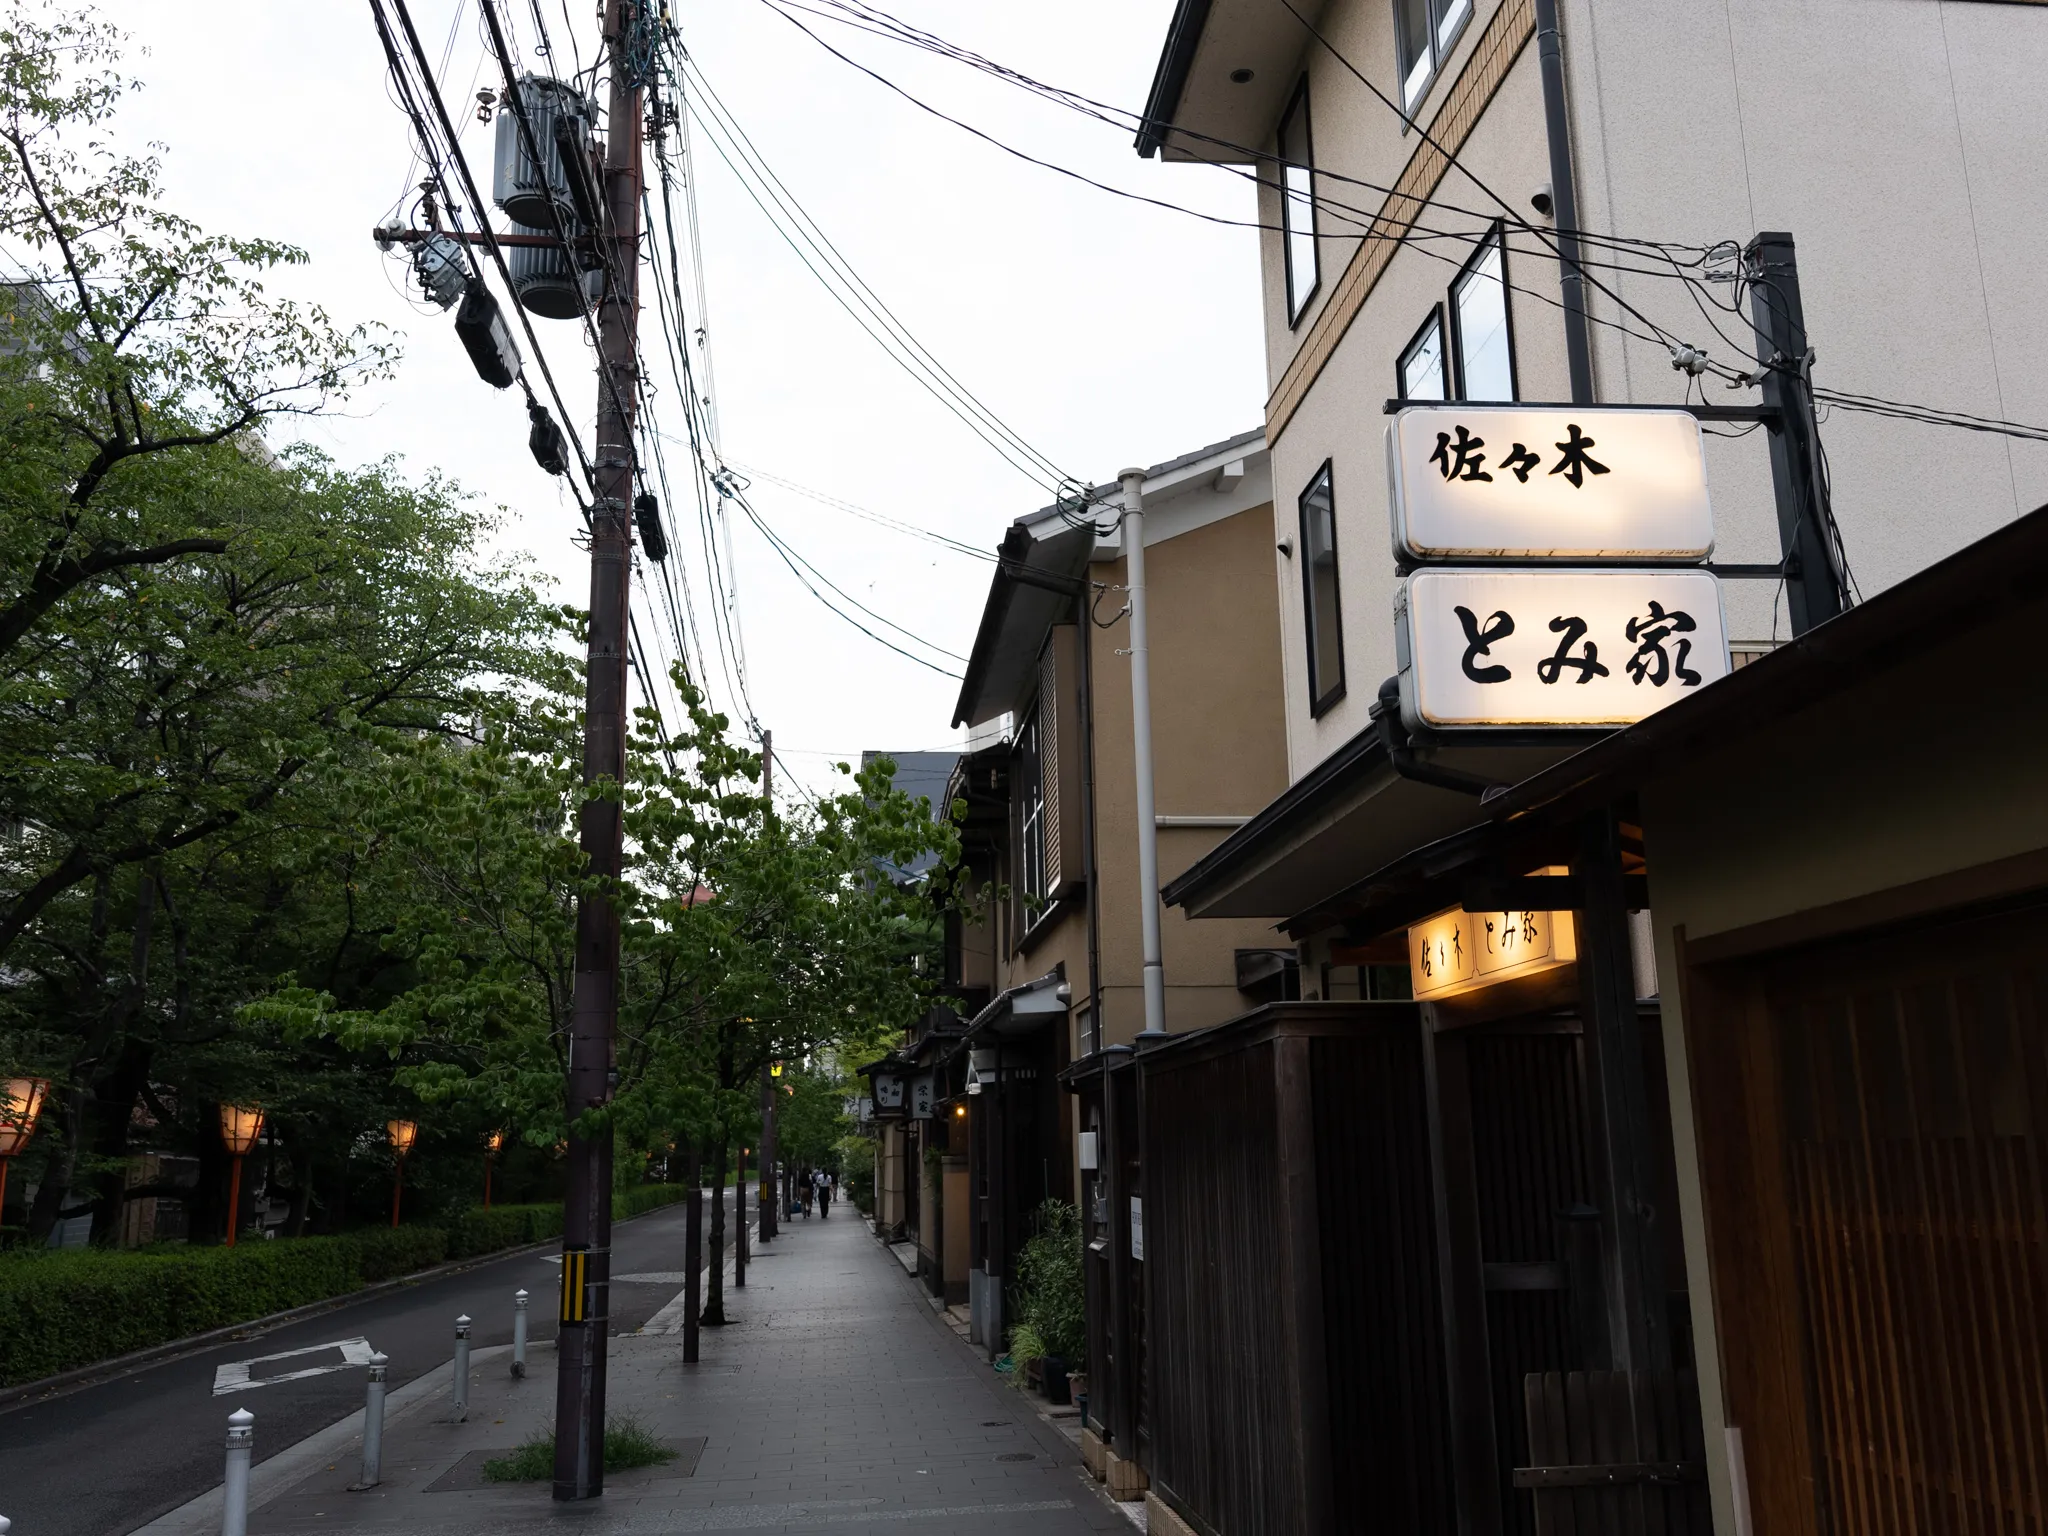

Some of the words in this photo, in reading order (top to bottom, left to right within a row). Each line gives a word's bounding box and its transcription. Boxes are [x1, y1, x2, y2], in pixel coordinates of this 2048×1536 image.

[1429, 424, 1611, 488] 佐々木
[1454, 600, 1702, 686] とみ家
[1421, 923, 1463, 977] 佐々木
[1485, 911, 1538, 954] とみ家
